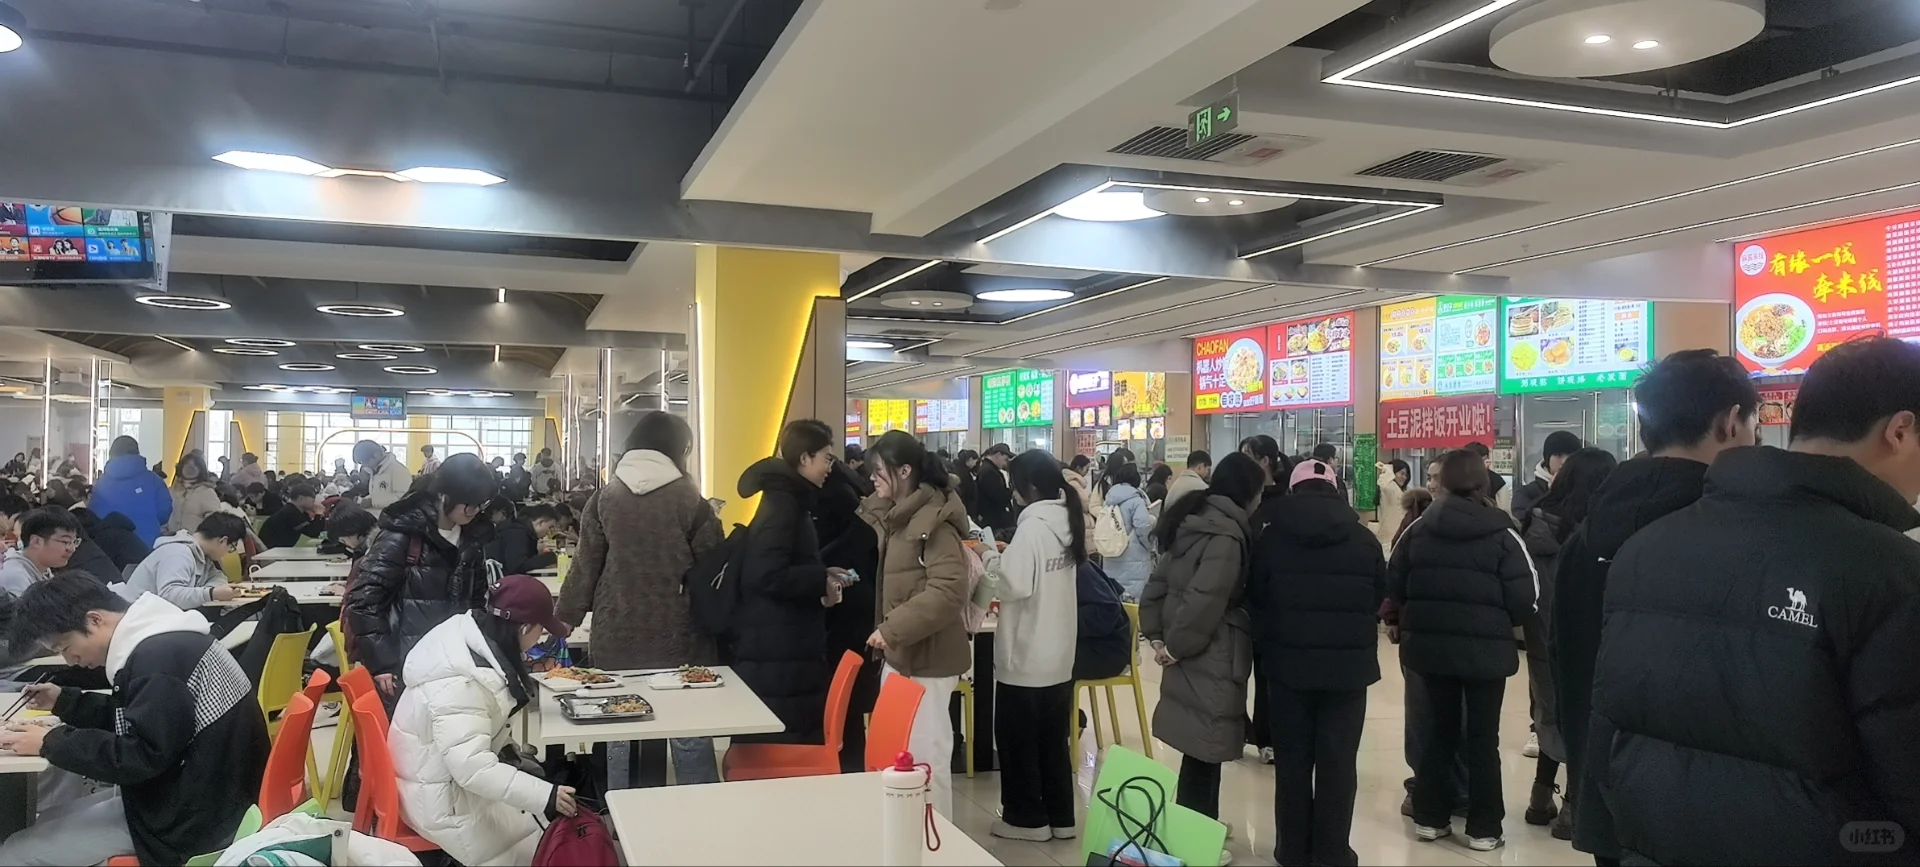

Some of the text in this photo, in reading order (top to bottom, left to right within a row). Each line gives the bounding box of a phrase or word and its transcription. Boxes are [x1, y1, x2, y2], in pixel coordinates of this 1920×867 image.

[1769, 242, 1857, 276] 有缘一线
[1813, 268, 1883, 304] 牵米线
[1196, 338, 1229, 357] CHAOFAN
[1386, 403, 1491, 439] 土豆泥拌饭开业啦!
[1767, 605, 1818, 628] CAMEL
